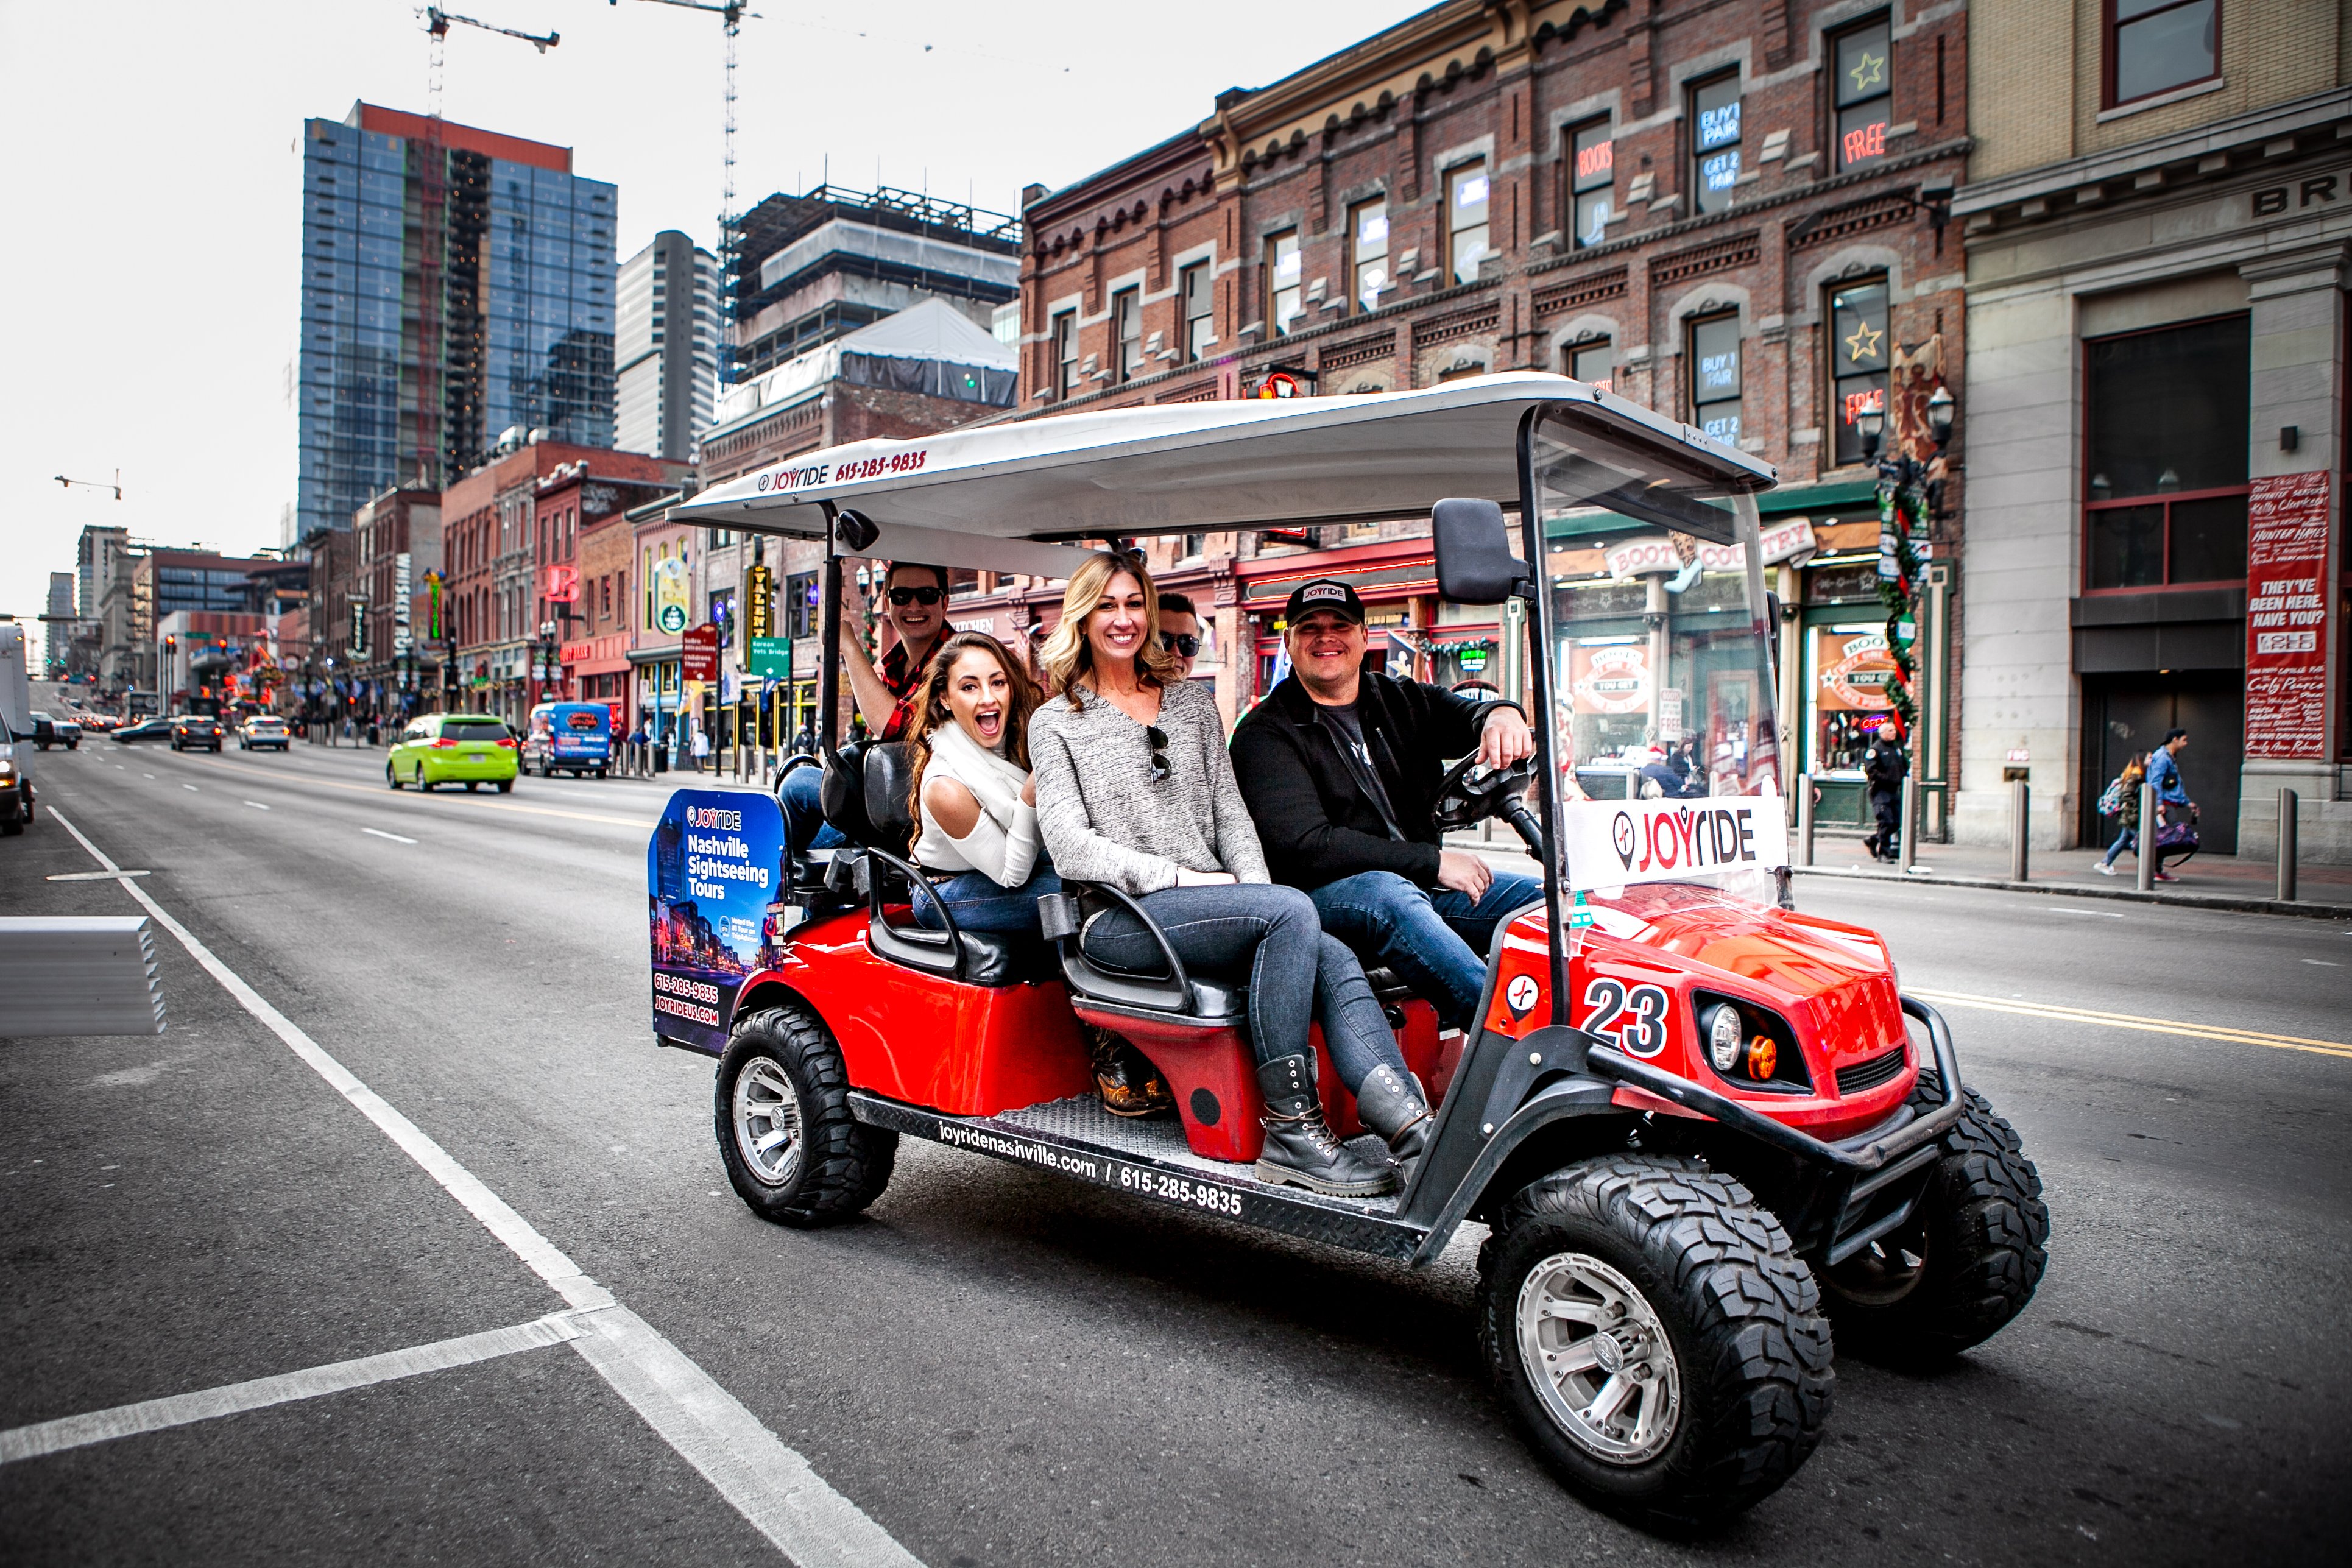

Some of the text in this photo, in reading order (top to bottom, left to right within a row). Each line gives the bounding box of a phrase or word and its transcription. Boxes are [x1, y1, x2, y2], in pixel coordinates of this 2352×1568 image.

[1701, 105, 1732, 130] BUY
[1703, 119, 1737, 146] PAIR
[1844, 122, 1886, 164] FREE
[1578, 141, 1613, 177] BOOTS
[1703, 151, 1739, 176] GET 2
[1708, 169, 1735, 191] PAIR
[2251, 172, 2352, 219] BR
[1701, 351, 1735, 373] BUY 1
[1707, 369, 1732, 386] PAIR
[1846, 389, 1884, 425] FRE
[1705, 416, 1738, 436] GET 2
[836, 450, 927, 482] 615-285-9835
[2251, 528, 2296, 542] HUNTER
[1615, 523, 1807, 571] BOOT COUTRY
[395, 553, 411, 624] WHISKEY
[2261, 578, 2316, 595] THEY'VE
[2249, 594, 2323, 612] BEEN HERE.
[2252, 610, 2325, 627] HAVE YOU?
[1848, 638, 1884, 654] BOO
[1600, 681, 1634, 690] YOU GET
[1853, 674, 1876, 682] YOU
[1661, 718, 1681, 731] FREE
[688, 835, 749, 858] Nashville
[688, 855, 769, 888] Sightseeing
[688, 878, 725, 900] Tours
[732, 917, 746, 926] Voted
[732, 933, 758, 943] TripAdvisor
[654, 973, 718, 1004] 615-285-9835
[655, 995, 719, 1026] JOYRIDEUS.COM
[1580, 978, 1668, 1058] 23
[939, 1121, 1242, 1216] joyridenashville.com / 615-285-9835
